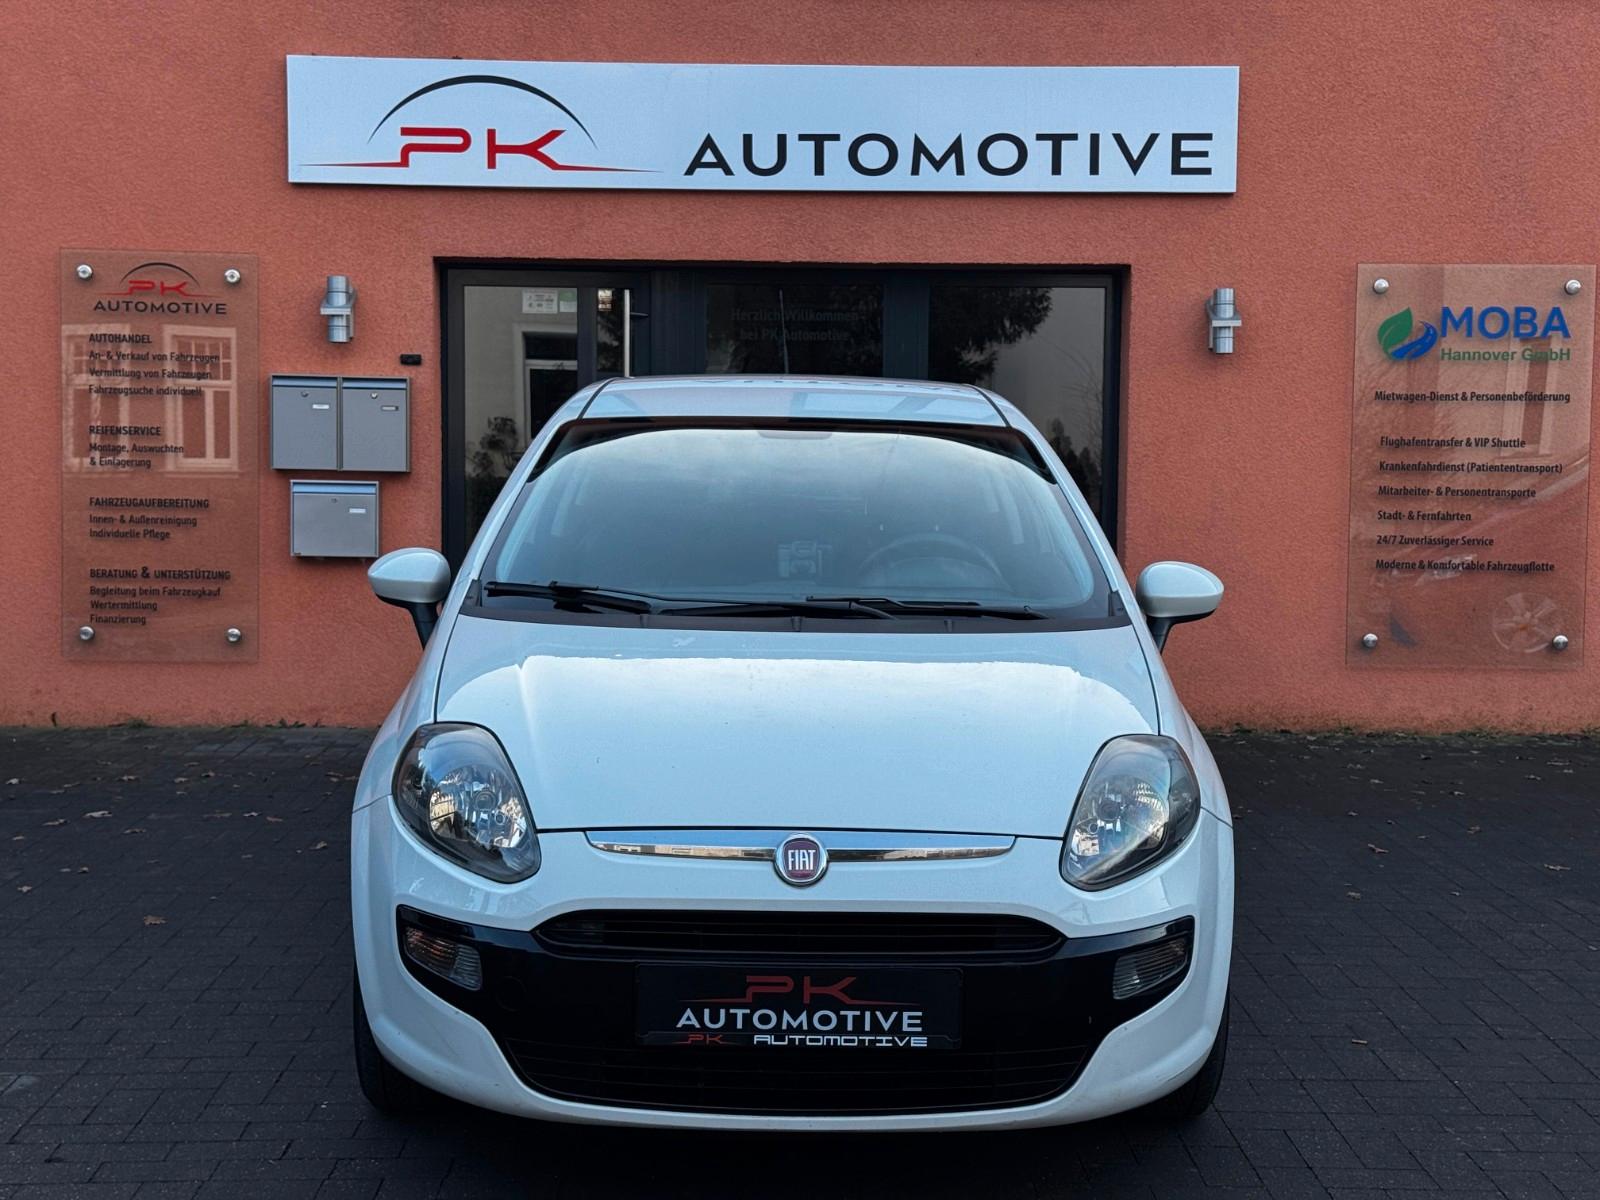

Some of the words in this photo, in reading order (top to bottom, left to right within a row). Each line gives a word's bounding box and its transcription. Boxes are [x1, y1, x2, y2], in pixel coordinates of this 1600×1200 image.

[400, 125, 567, 170] PK
[683, 131, 1213, 177] AUTOMOTIVE
[93, 300, 228, 315] AUTOMOTIVE
[1440, 306, 1571, 339] MOBA
[88, 333, 152, 344] AUTOHANDEL
[88, 350, 104, 360] An-
[106, 351, 113, 360] &
[115, 351, 150, 361] Verkauf
[152, 353, 167, 361] von
[170, 352, 220, 364] Fahrzeugen
[1440, 348, 1516, 361] Hannover
[1521, 348, 1571, 361] GmbH
[89, 368, 141, 379] Vermittlung
[161, 369, 213, 380] Fahrzeugen
[88, 385, 154, 396] Fahrzeugsuche
[156, 386, 203, 396] individuell
[1375, 391, 1459, 403] Mietwagen-Dienst
[1460, 392, 1467, 401] &
[1470, 391, 1571, 403] Personenbeförderung
[89, 425, 161, 436] REIFENSERVICE
[89, 442, 129, 454] Montage,
[131, 443, 184, 454] Auswuchten
[1380, 436, 1463, 449] Flughafentransfer
[1465, 438, 1473, 448] &
[1474, 438, 1490, 448] VIP
[1491, 437, 1526, 448] Shuttle
[89, 456, 97, 466] &
[99, 457, 151, 469] Einlagerung
[1379, 461, 1465, 472] Krankenfahrdienst
[1466, 461, 1563, 475] (Patiententransport)
[1378, 486, 1434, 497] Mitarbeiter-
[1436, 487, 1443, 497] &
[1445, 487, 1536, 499] Personentransporte
[89, 497, 209, 508] FAHRZEUGAUFBEREITUNG
[89, 514, 117, 524] Innen-
[119, 515, 126, 524] &
[128, 514, 197, 527] Außenreinigung
[1377, 511, 1406, 521] Stadt-
[1407, 511, 1415, 521] &
[1416, 511, 1472, 521] Fernfahrten
[89, 528, 141, 539] Individuelle
[143, 529, 170, 541] Pflege
[1376, 535, 1397, 545] 24/7
[1398, 535, 1460, 548] Zuverlässiger
[1461, 536, 1494, 546] Service
[1376, 559, 1416, 571] Moderne
[1418, 561, 1425, 571] &
[1427, 560, 1485, 571] Komfortable
[1487, 560, 1555, 574] Fahrzeugflotte
[89, 568, 138, 579] BERATUNG
[140, 566, 151, 579] &
[154, 568, 231, 581] UNTERSTÜTZUNG
[90, 586, 136, 598] Begleitung
[138, 586, 160, 596] beim
[162, 586, 221, 599] Fahrzeugkauf
[90, 600, 158, 612] Wertermittlung
[90, 614, 146, 626] Finanzierung
[787, 849, 816, 871] FIAT
[676, 1007, 923, 1032] AUTOMOTIVE
[753, 1034, 928, 1047] AUTOMOTIVE
